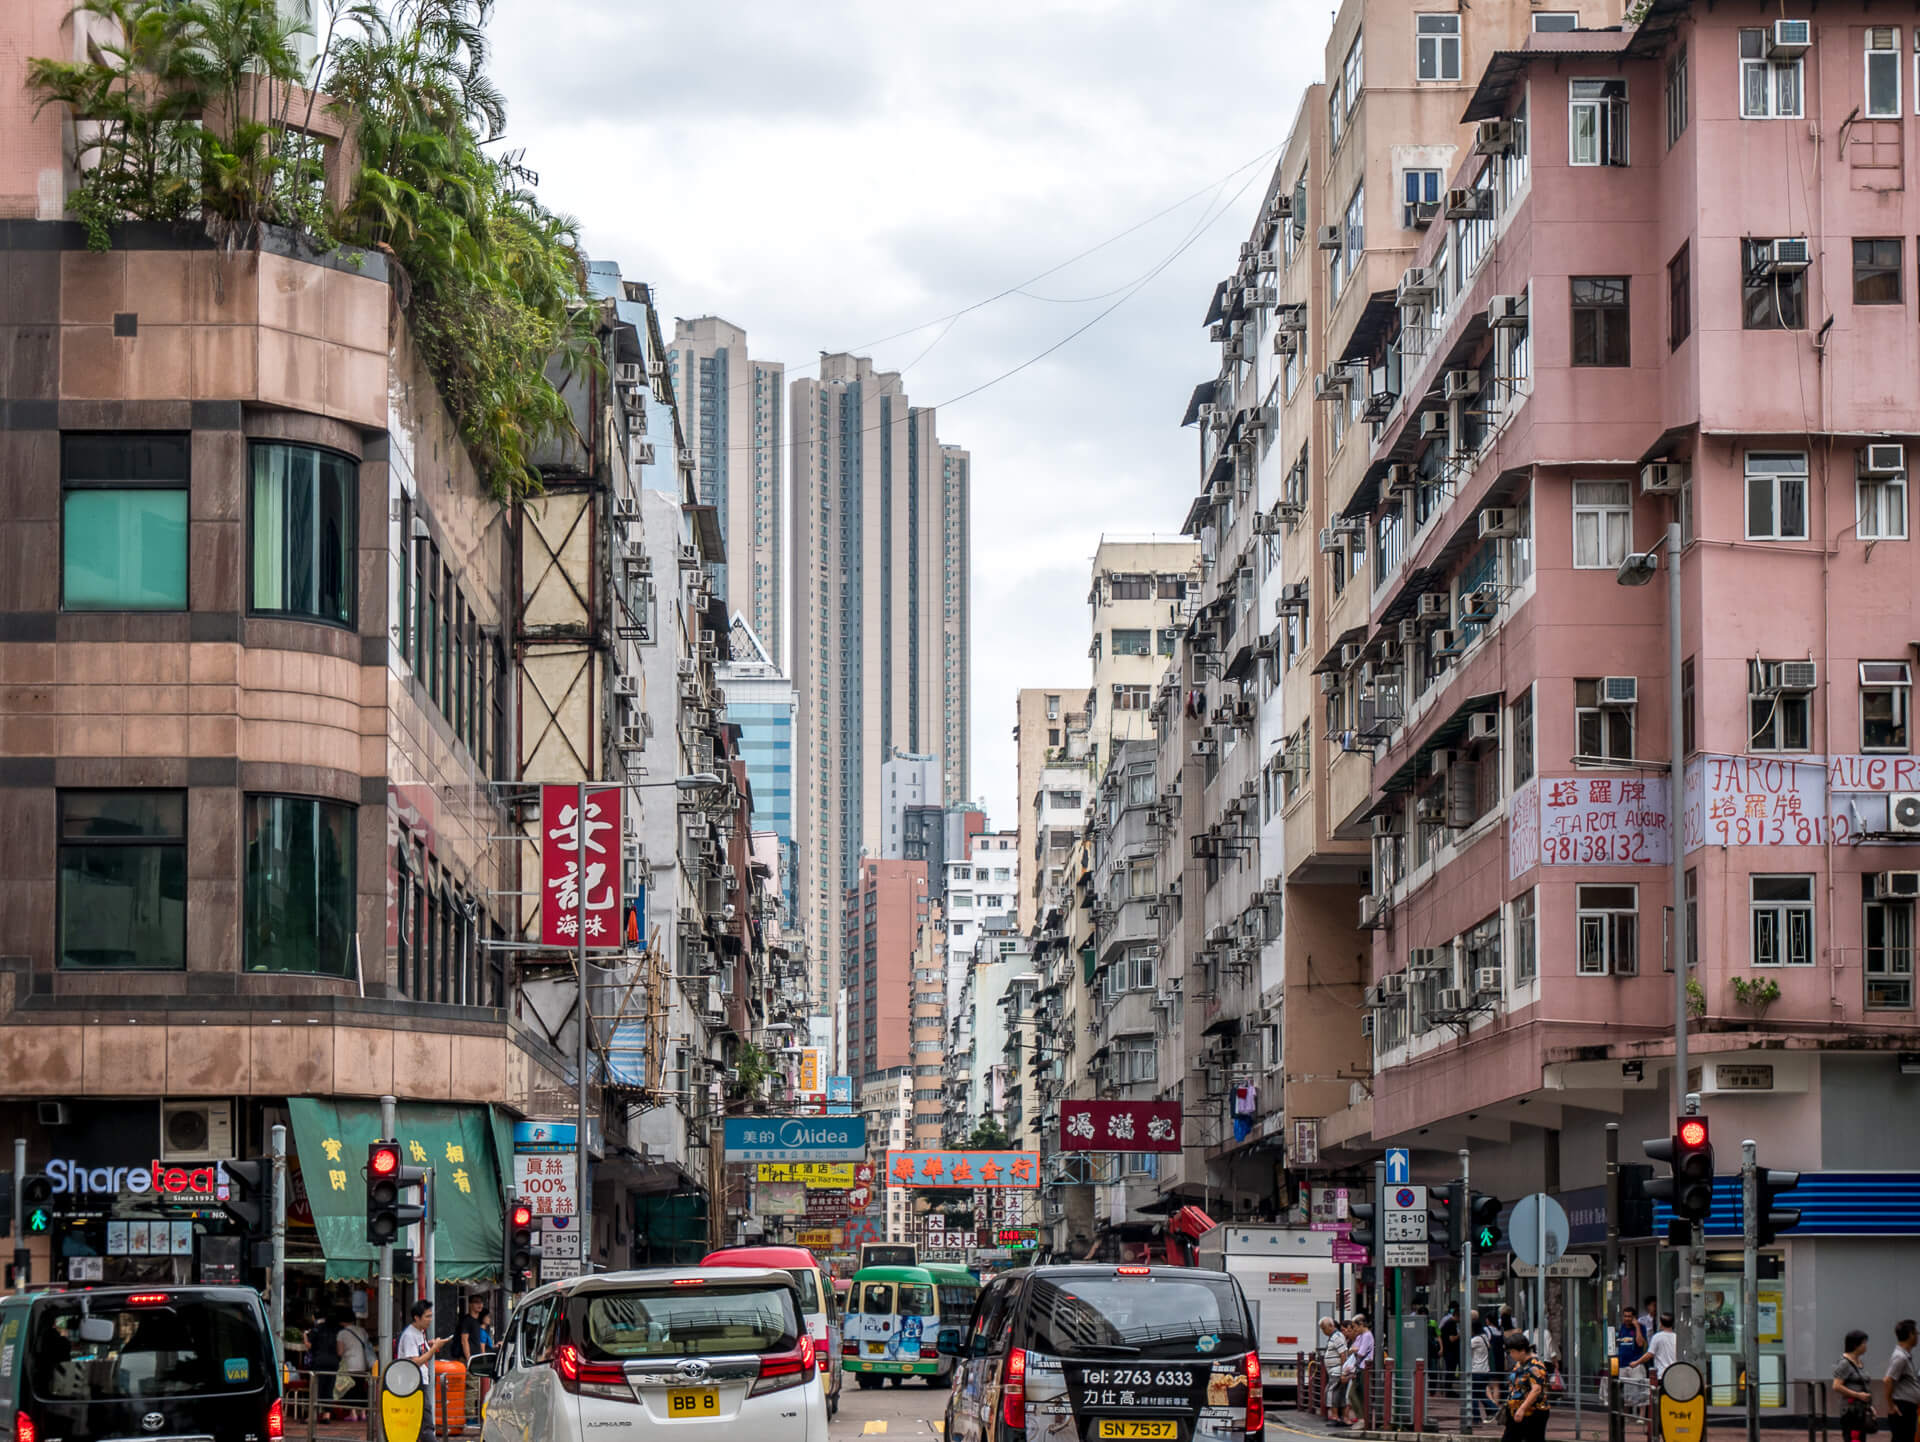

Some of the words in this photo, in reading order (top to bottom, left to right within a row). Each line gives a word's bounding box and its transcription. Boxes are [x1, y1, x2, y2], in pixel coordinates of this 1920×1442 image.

[1547, 780, 1647, 809] 塔羅牌
[1709, 794, 1803, 825] 塔羅牌
[1716, 817, 1785, 846] 9813
[1544, 833, 1651, 864] 98138132
[743, 1130, 775, 1144] 美的
[791, 1128, 848, 1144] Midea
[521, 1178, 567, 1193] 100%
[1400, 1214, 1425, 1223] 8-10
[556, 1235, 578, 1243] 8-10
[1401, 1228, 1421, 1237] 5-7
[1082, 1369, 1109, 1385] Tel:
[1113, 1370, 1151, 1385] 2763
[1155, 1371, 1193, 1386] 6333
[674, 1396, 696, 1410] BB
[703, 1395, 714, 1409] 8
[1104, 1423, 1126, 1436] SN
[1130, 1423, 1172, 1436] 7537
